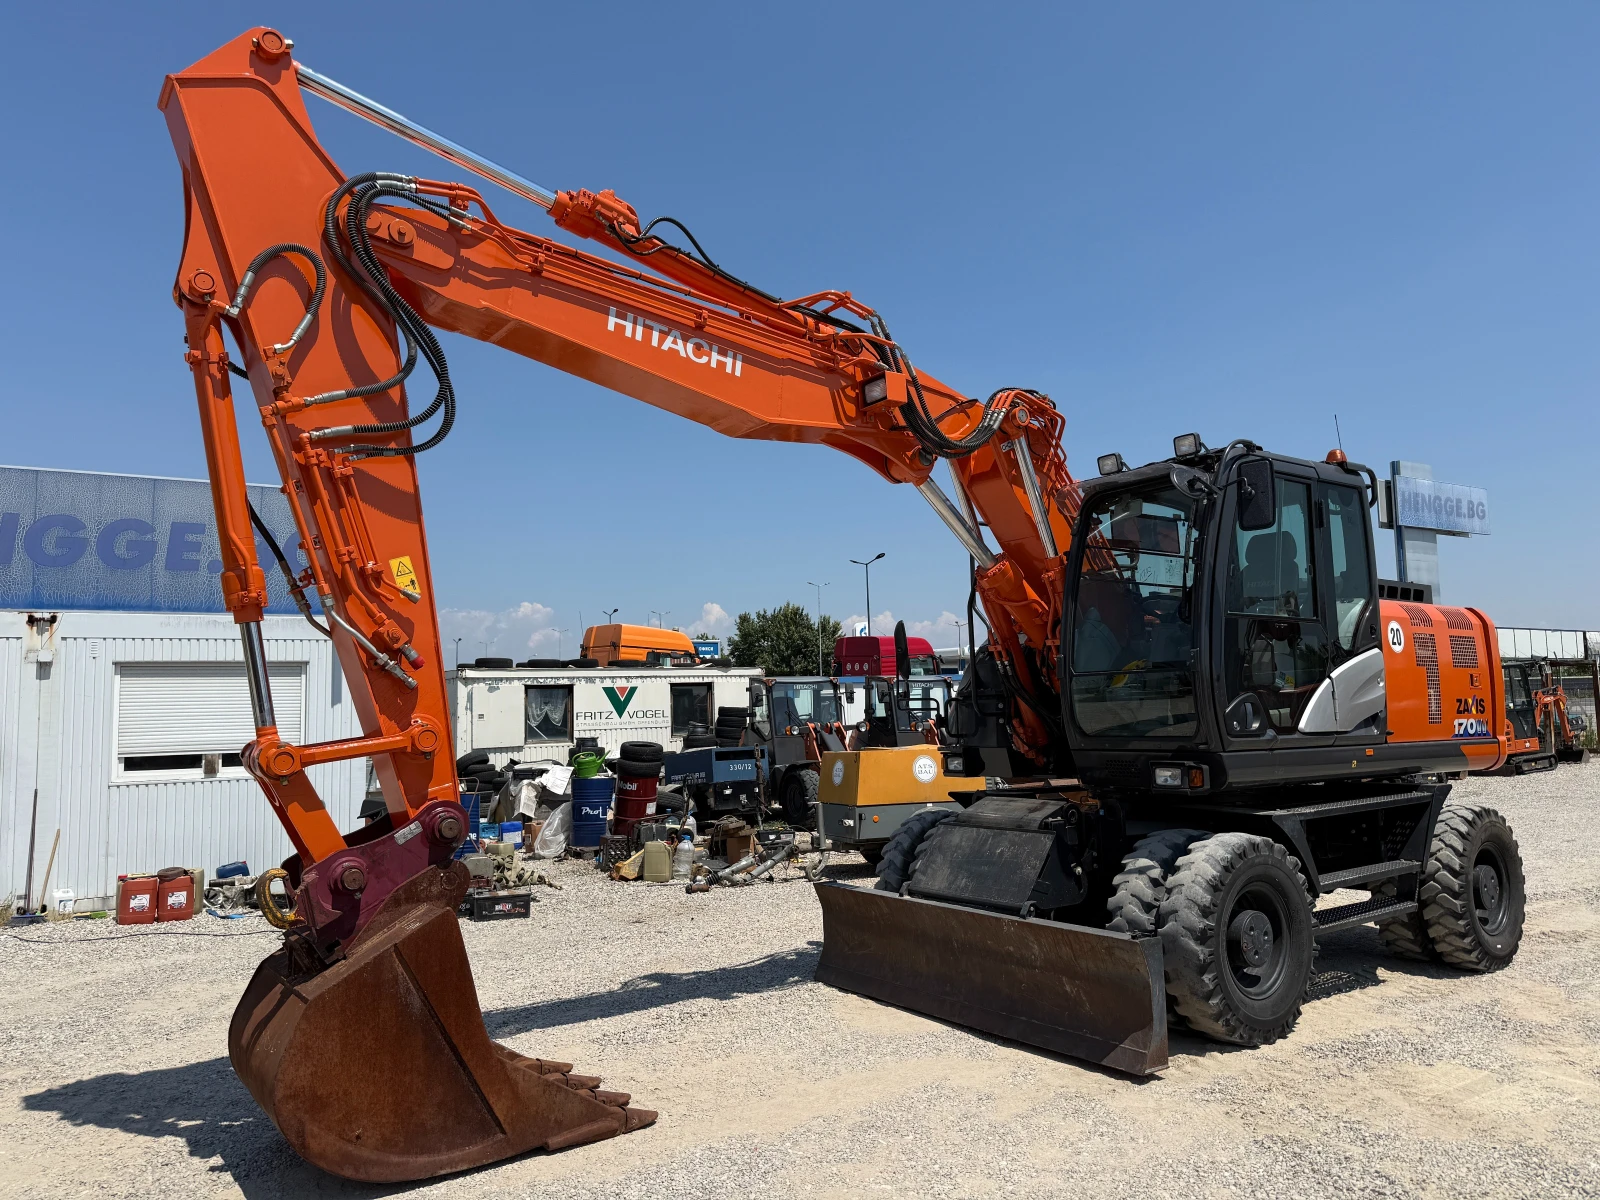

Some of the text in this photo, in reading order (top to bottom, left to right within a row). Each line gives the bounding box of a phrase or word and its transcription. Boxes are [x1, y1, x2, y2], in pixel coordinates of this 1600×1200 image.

[607, 296, 743, 378] HITACHI
[1400, 490, 1486, 521] HENGGE.BG
[1390, 627, 1402, 646] 20
[1456, 694, 1486, 715] ZAXIS
[575, 709, 669, 721] FRITZ VOGEL
[1453, 718, 1488, 735] 170W
[729, 763, 752, 771] 330/12
